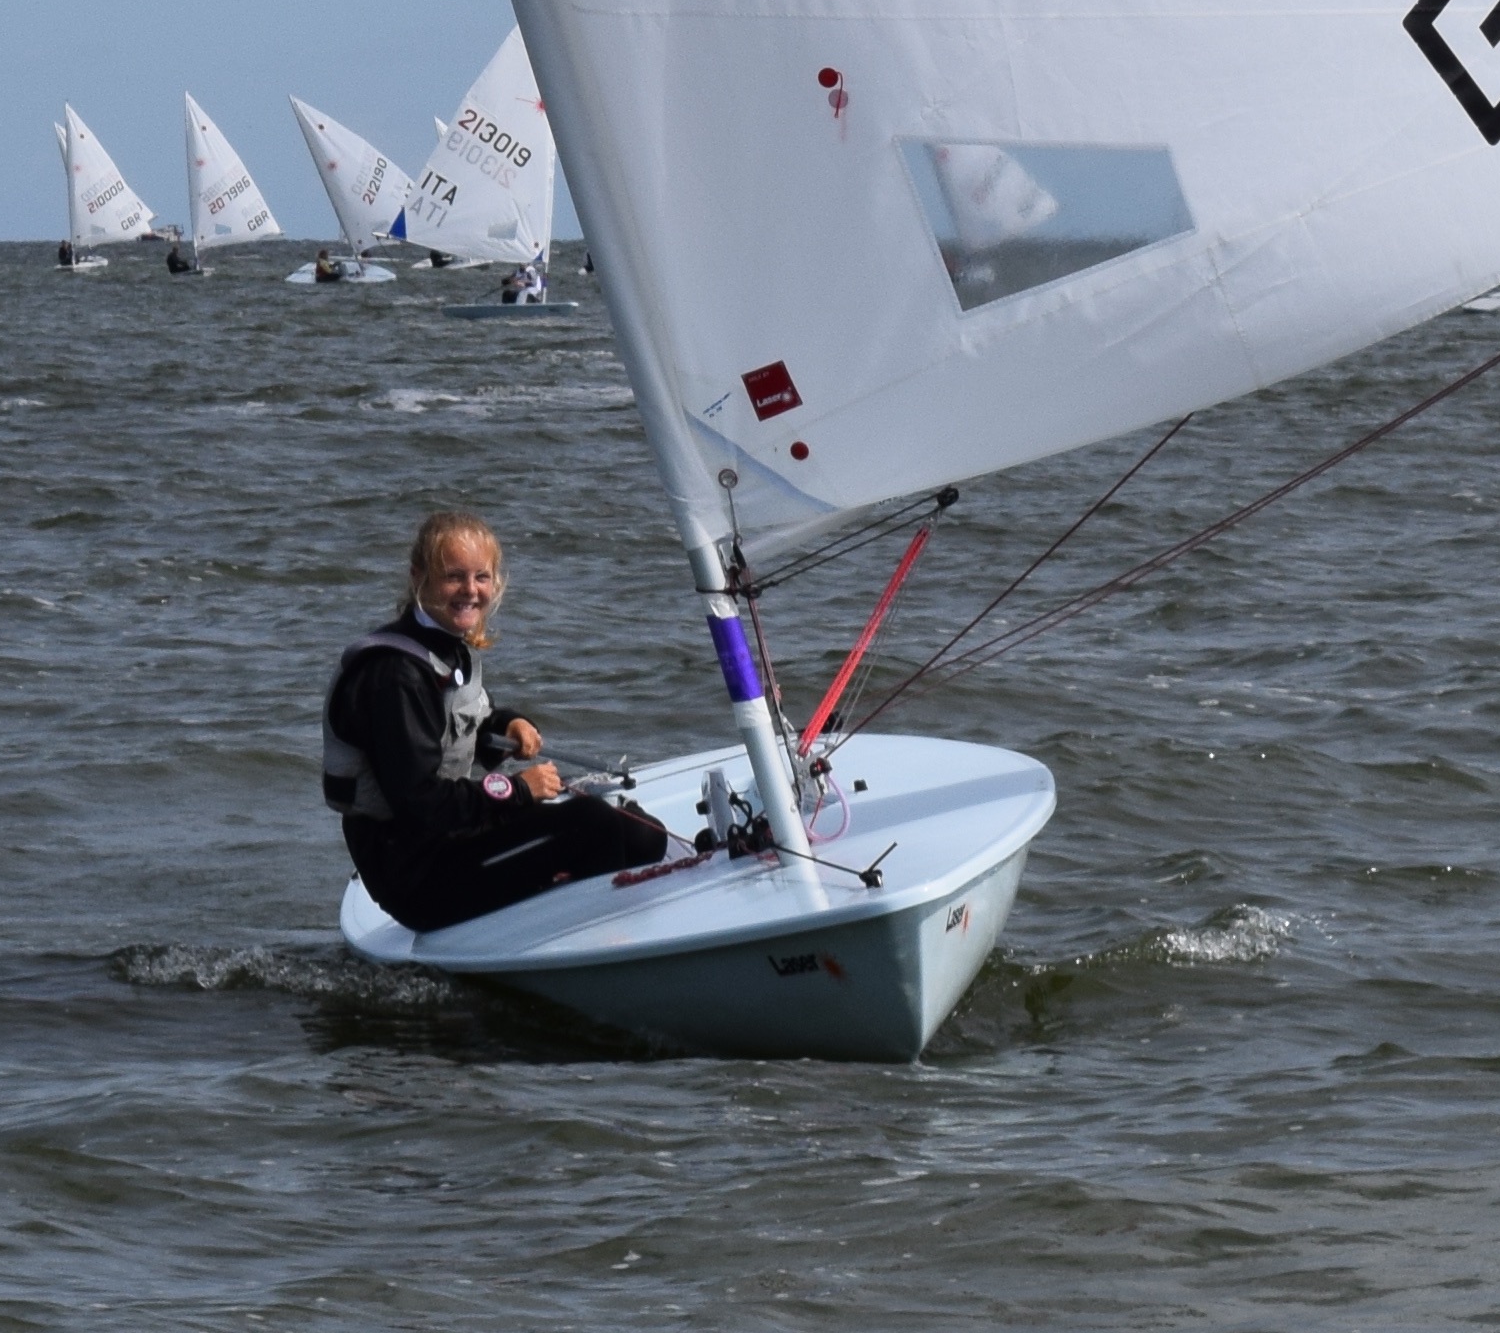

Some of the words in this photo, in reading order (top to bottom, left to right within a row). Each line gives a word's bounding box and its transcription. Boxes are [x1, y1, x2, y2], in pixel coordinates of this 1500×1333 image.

[458, 109, 532, 168] 213019
[208, 175, 252, 215] 207986
[363, 157, 388, 205] 212190
[421, 171, 458, 206] ITA
[86, 180, 125, 215] 210000
[120, 212, 141, 231] GBR
[247, 210, 269, 232] GBR
[756, 391, 782, 408] Laser
[945, 903, 966, 933] Laser
[768, 953, 820, 977] Laser
